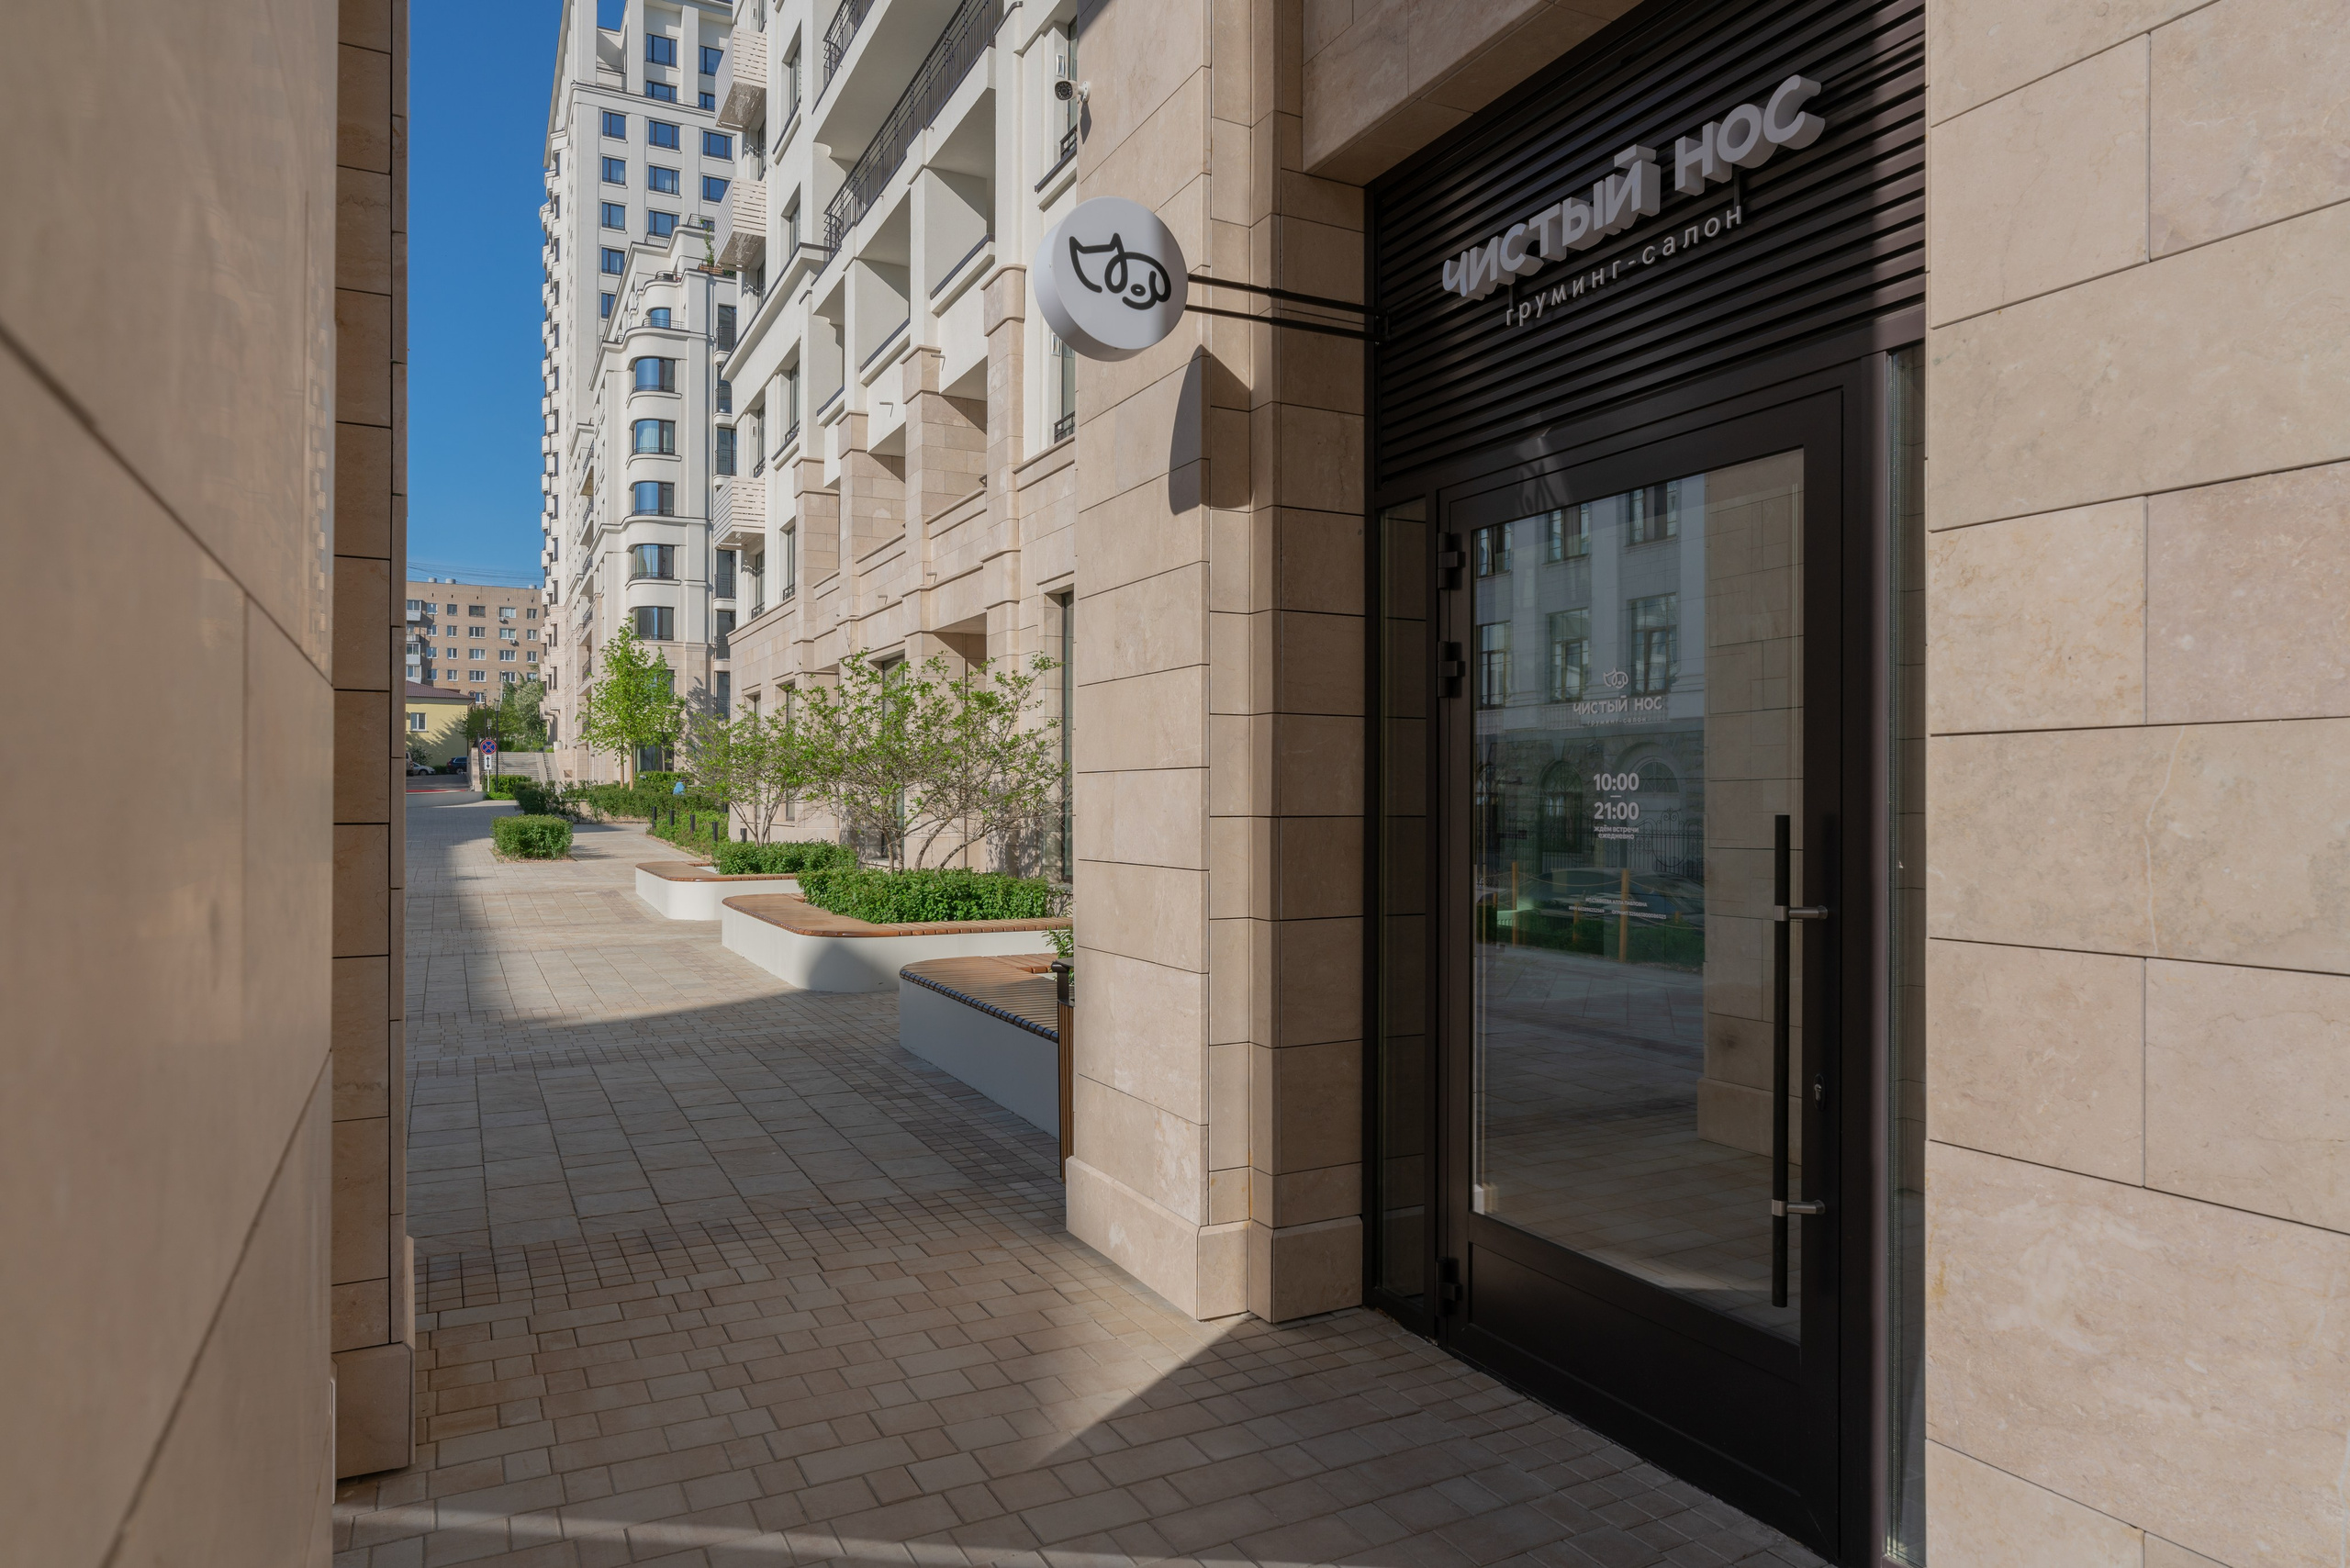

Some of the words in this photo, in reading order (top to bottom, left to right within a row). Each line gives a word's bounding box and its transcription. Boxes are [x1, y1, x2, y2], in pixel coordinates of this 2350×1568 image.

[1442, 144, 1661, 301] ЧИСТЫЙ
[1675, 74, 1826, 196] НОС
[1505, 205, 1742, 327] груминг-салон
[1572, 694, 1628, 716] ЧИСТЫЙ
[1634, 695, 1662, 711] НОС
[1587, 716, 1647, 727] груминг-салон
[1593, 772, 1639, 791] 10:00
[1594, 801, 1639, 821] 21:00
[1612, 825, 1639, 834] встречи
